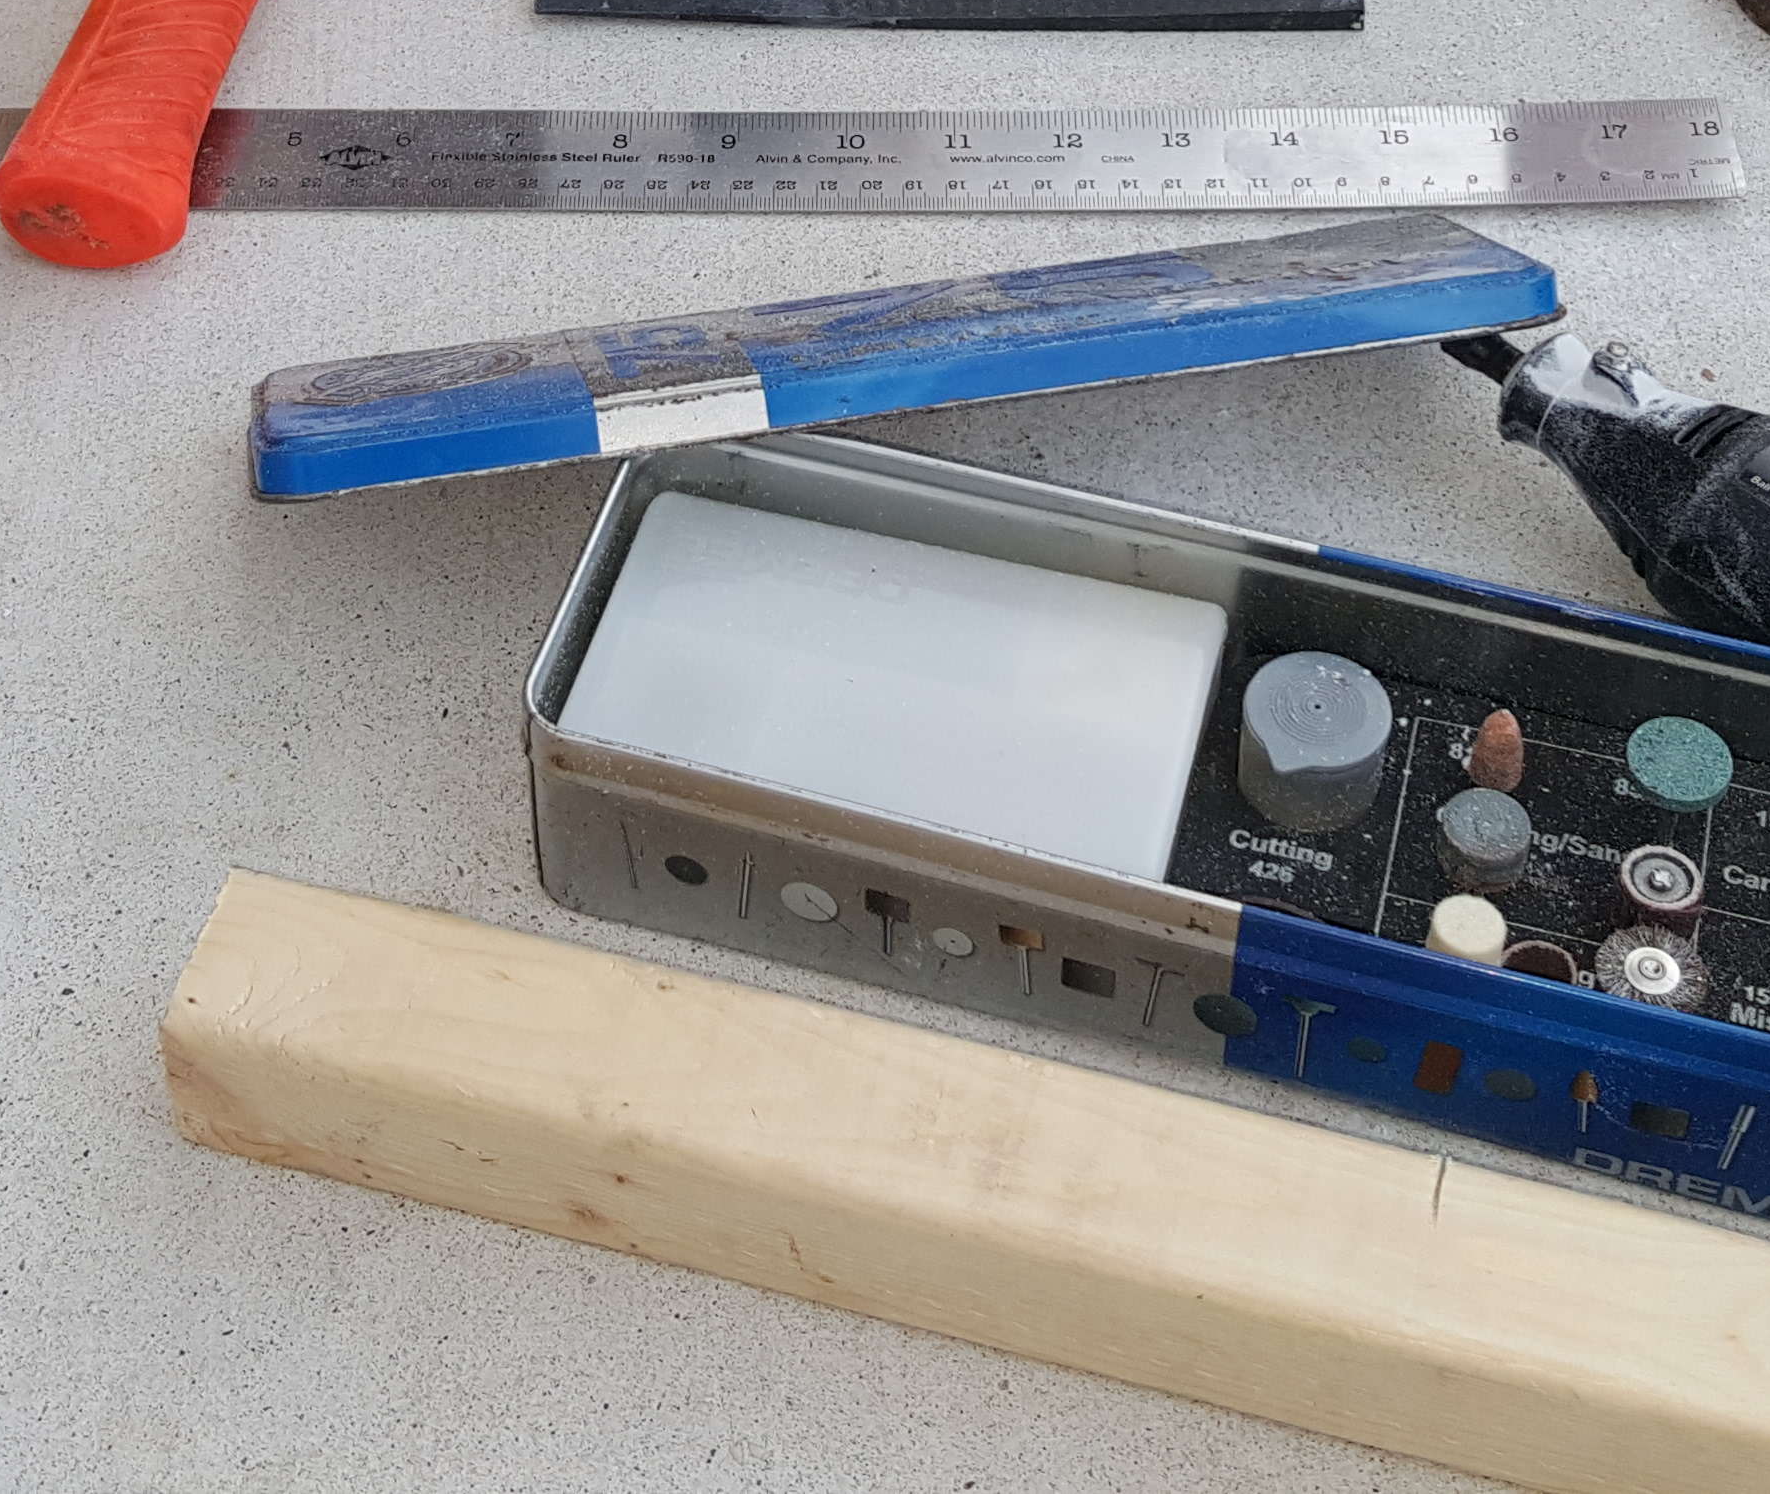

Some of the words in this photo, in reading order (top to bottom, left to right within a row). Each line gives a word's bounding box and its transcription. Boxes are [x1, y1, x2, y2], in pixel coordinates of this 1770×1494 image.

[287, 132, 302, 148] 5
[395, 131, 413, 148] 6
[612, 133, 629, 149] 8
[721, 133, 737, 150] 9
[835, 133, 866, 149] 10
[944, 133, 972, 149] 11
[1052, 133, 1084, 149] 12
[1161, 131, 1192, 148] 13
[1268, 130, 1300, 147] 14
[1379, 129, 1411, 145] 15
[1489, 127, 1520, 143] 16
[1600, 123, 1628, 140] 17
[1689, 121, 1721, 137] 18
[561, 151, 598, 163] Steel
[602, 152, 641, 164] Ruler
[755, 153, 790, 165] Alvin
[793, 153, 803, 165] &
[806, 153, 874, 167] Company,
[878, 153, 903, 165] Inc.
[949, 152, 1066, 164] www.alvinco.com
[1101, 155, 1135, 163] CHINA
[1229, 828, 1334, 871] Cutting
